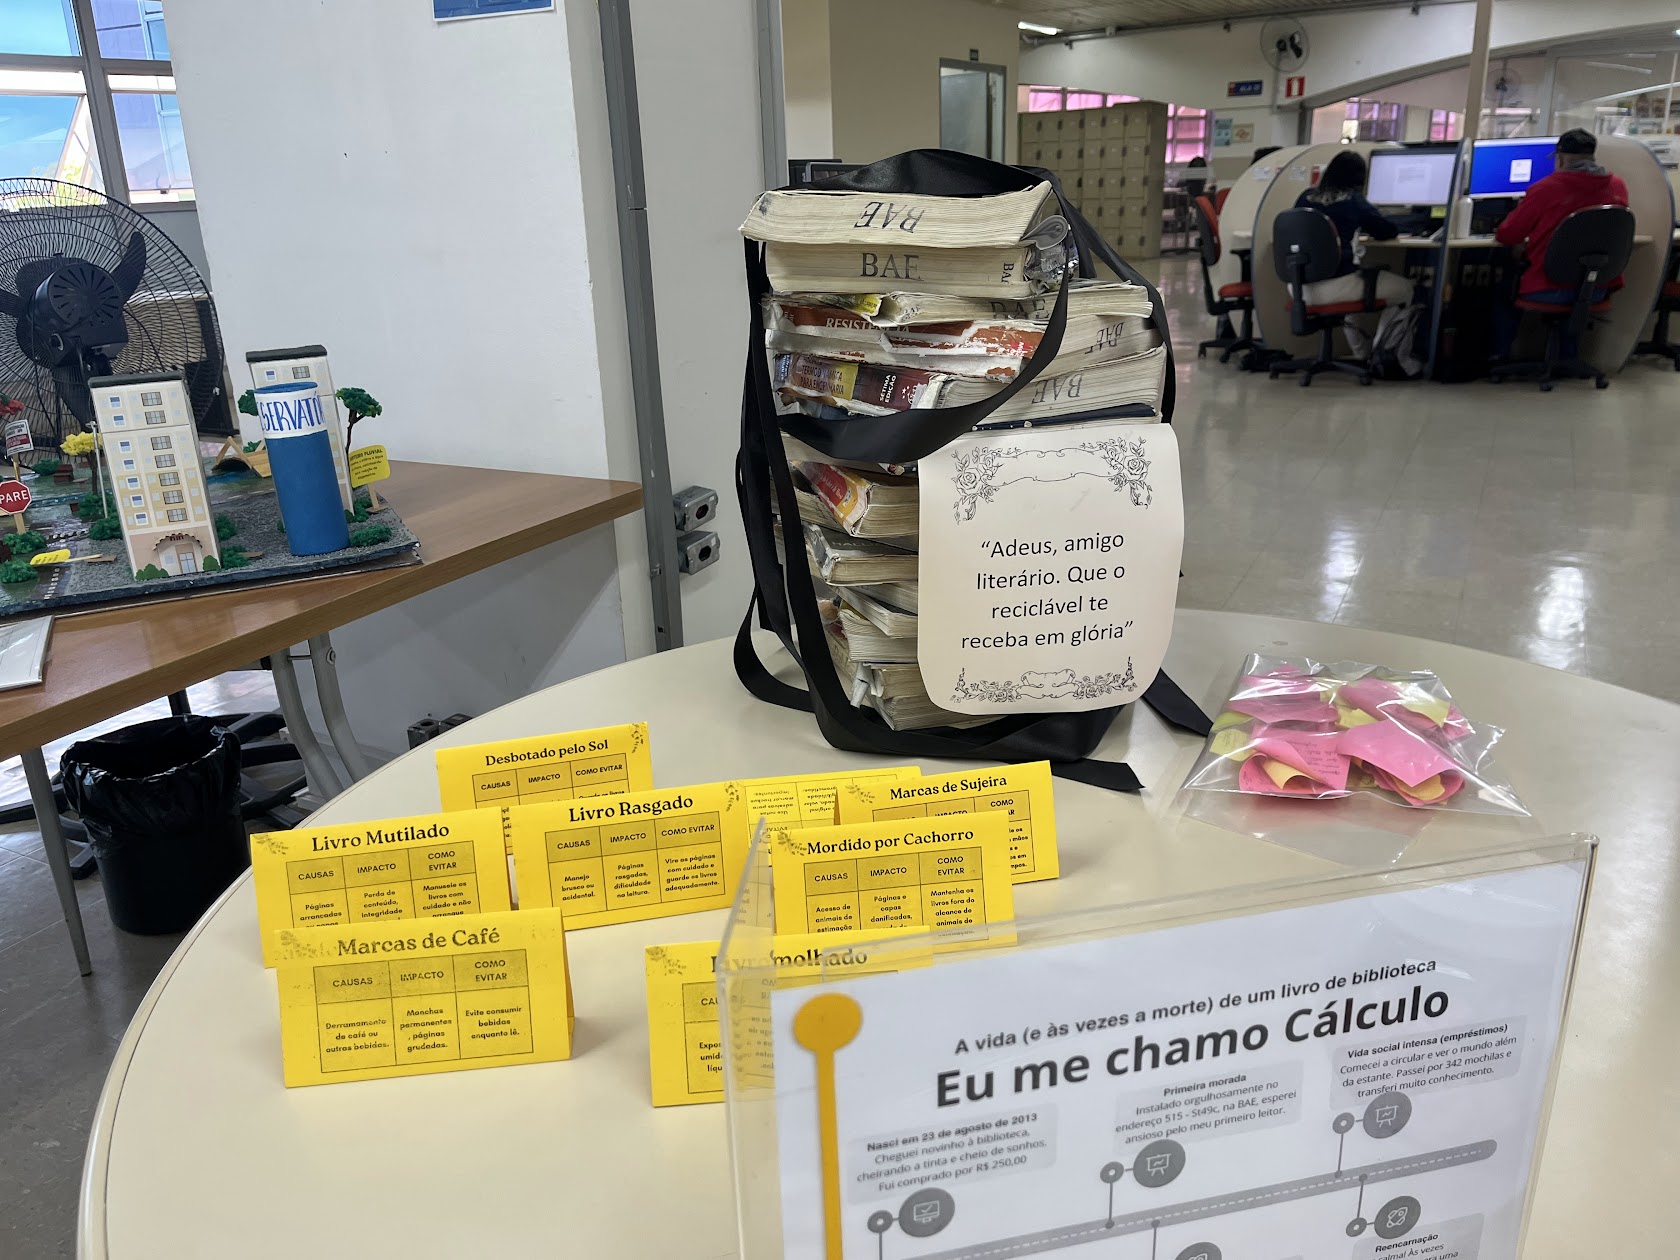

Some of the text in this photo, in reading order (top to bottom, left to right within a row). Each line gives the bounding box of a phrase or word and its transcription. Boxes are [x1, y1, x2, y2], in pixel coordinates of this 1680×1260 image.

[854, 201, 925, 233] BAE
[860, 252, 925, 282] BAE
[1031, 373, 1084, 405] BAE
[980, 532, 1124, 559] “Adeus, amigo
[976, 565, 1125, 590] literário. Que o
[991, 596, 1109, 619] reciclável te
[961, 620, 1134, 649] receba em glória”
[485, 739, 609, 766] Desbotado pelo Sol
[481, 764, 623, 791] CAUSAS IMPACTO COMO EVITAR
[890, 776, 1008, 800] Marcas de Sujeira
[568, 806, 615, 823] Livro
[619, 795, 693, 816] Rasgado
[990, 799, 1014, 808] COMO
[312, 824, 450, 852] Livro Mutilado
[557, 824, 715, 850] CAUSAS IMPACTO COMO EVITAR
[807, 830, 974, 855] Mordido por Cachorro
[428, 850, 456, 860] COMO
[428, 862, 457, 872] EVITAR
[937, 856, 964, 865] COMO
[298, 863, 397, 881] CAUSAS IMPACTO
[814, 866, 907, 882] CAUSAS IMPACTO
[937, 867, 965, 876] EVITAR
[337, 927, 500, 956] Marcas de Café
[474, 959, 506, 969] COMO
[332, 970, 444, 988] CAUSAS IMPACTO
[475, 972, 508, 983] EVITAR
[406, 1007, 444, 1016] Manchas
[486, 1006, 522, 1015] consumir
[955, 960, 1437, 1055] A vida (e às vezes a morte) de um livro de biblioteca
[347, 1030, 367, 1040] café
[478, 1018, 511, 1028] bebidas
[937, 985, 1449, 1108] Eu me chamo Cálculo
[1347, 1023, 1508, 1059] Vida social intensa (empréstimos)
[1340, 1035, 1517, 1075] Comecei a circular e ver o mundo além
[1342, 1050, 1512, 1088] da estante. Passei por 342 mochilas e
[1163, 1073, 1247, 1097] Primeira morada
[1357, 1066, 1495, 1098] transferi muito conhecimento.
[1136, 1081, 1279, 1116] Instalado orgulhosamente no
[1115, 1115, 1162, 1133] endereço
[1165, 1111, 1183, 1123] 515
[1222, 1102, 1236, 1112] na
[1261, 1090, 1297, 1105] esperei
[867, 1113, 1037, 1152] Nasci em 23 de agosto de 2013
[1124, 1106, 1286, 1144] ansioso pelo meu primeiro leitor.
[921, 1139, 965, 1155] novinho
[976, 1161, 989, 1173] R$
[992, 1155, 1027, 1170] 250,00
[1375, 1233, 1439, 1253] Reencarnação
